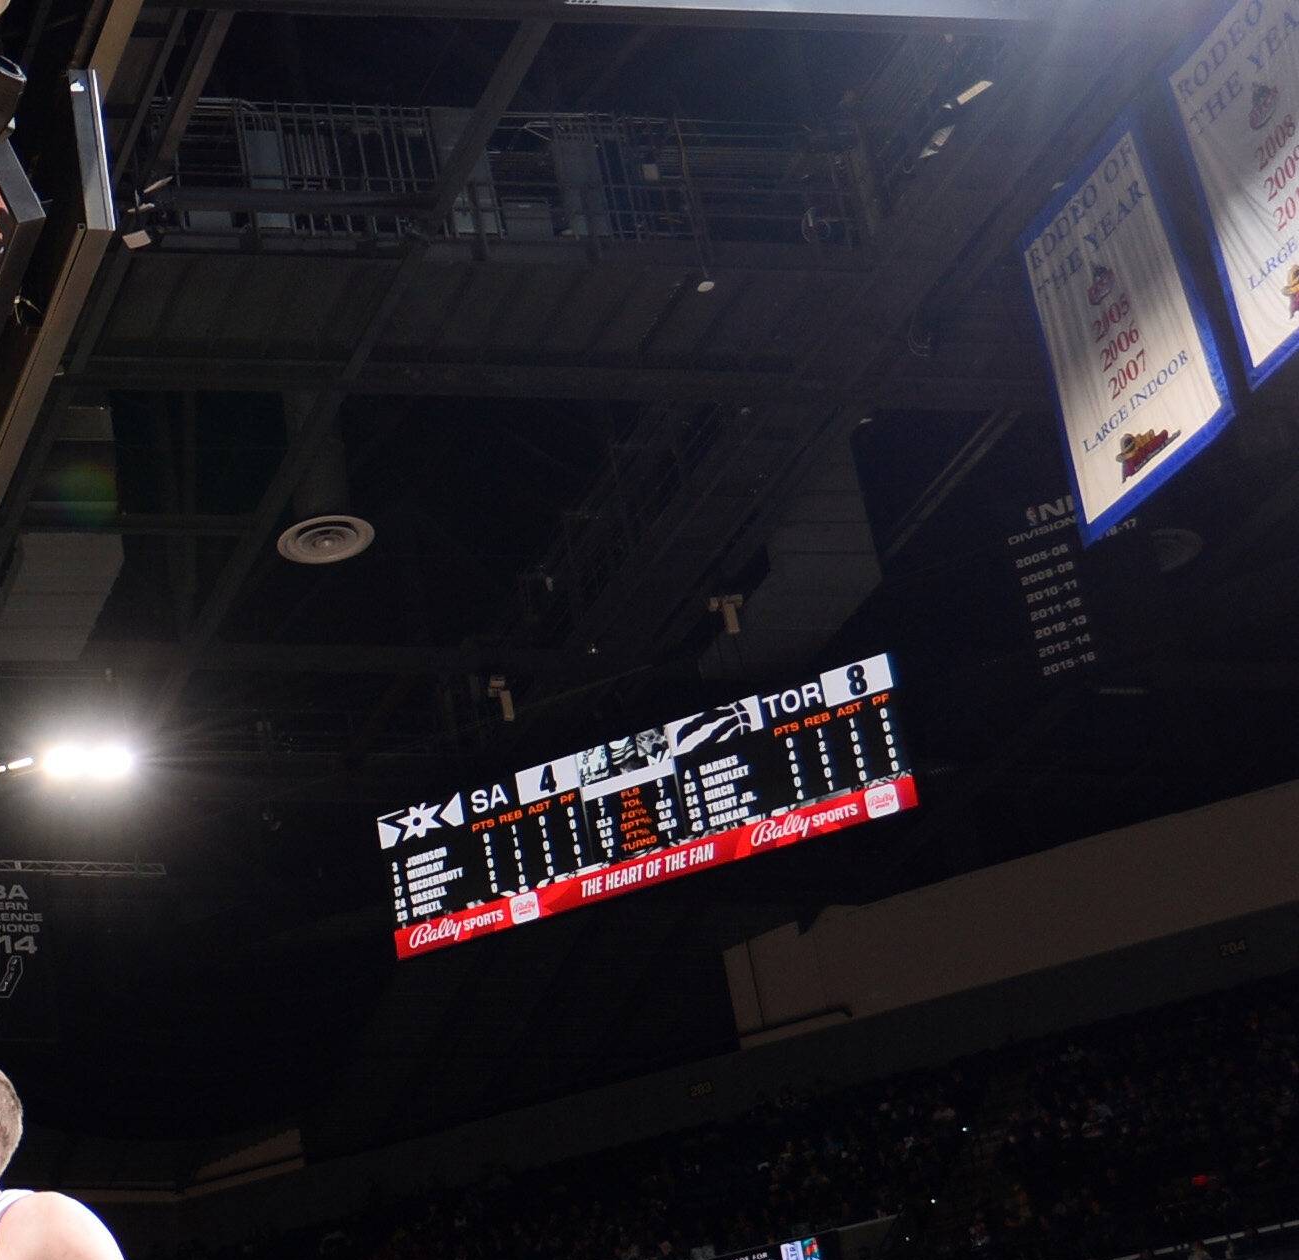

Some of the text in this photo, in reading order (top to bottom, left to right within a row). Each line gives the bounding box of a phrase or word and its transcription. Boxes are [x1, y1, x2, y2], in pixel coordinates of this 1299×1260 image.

[1100, 323, 1139, 373] 2006
[1108, 351, 1148, 400] 2007
[1083, 350, 1188, 453] LARGE INDOOR
[762, 664, 868, 718] TOR 8
[471, 764, 557, 813] SA 4
[751, 803, 858, 850] Bally SPORTS
[409, 909, 503, 949] Bally SPORTS
